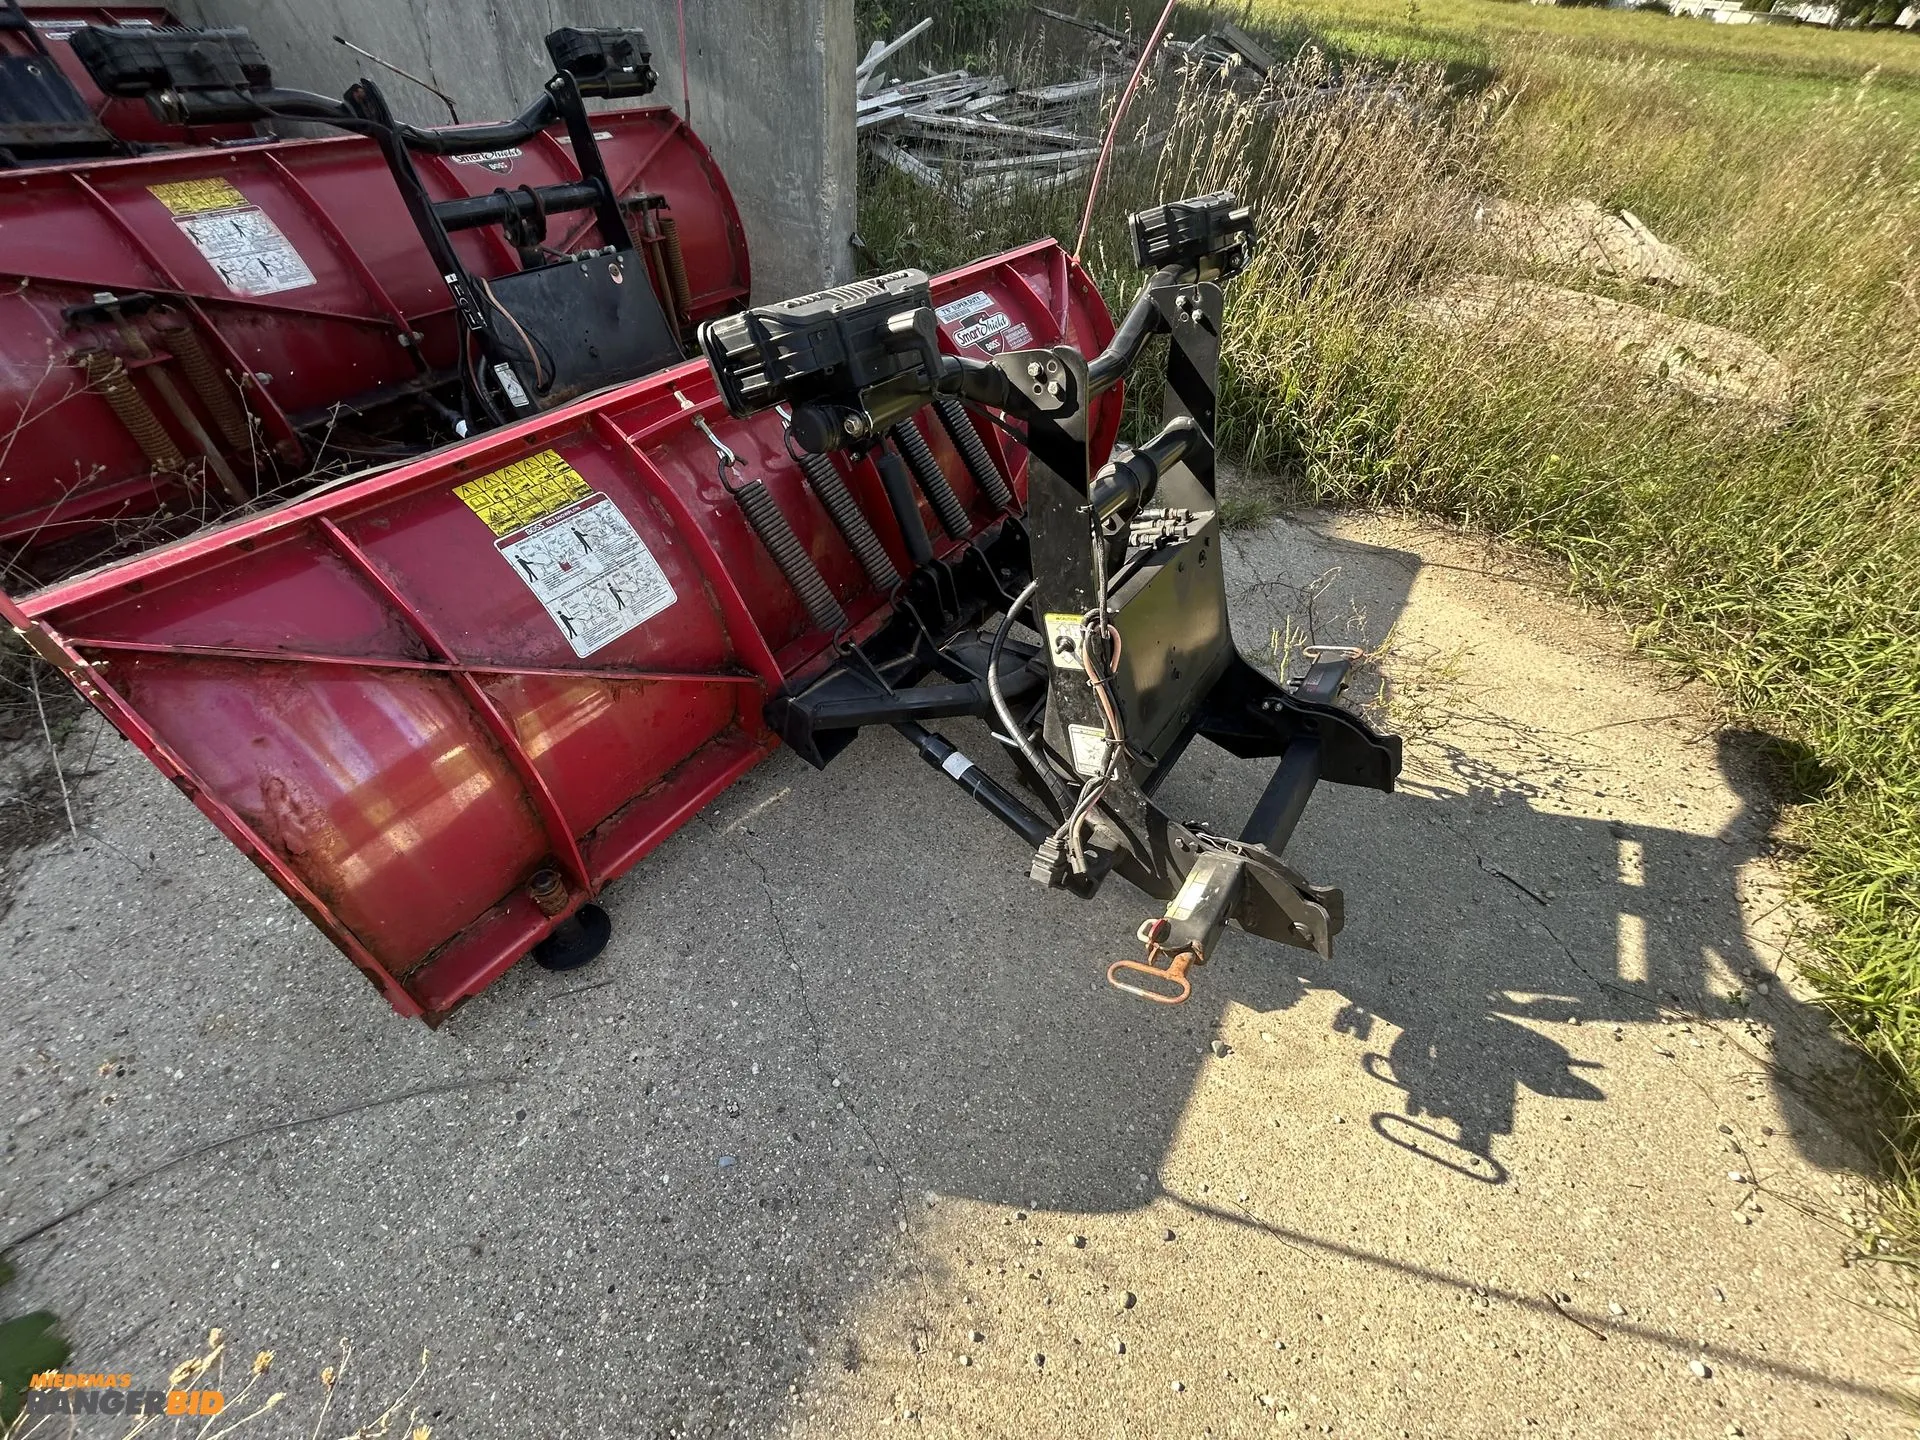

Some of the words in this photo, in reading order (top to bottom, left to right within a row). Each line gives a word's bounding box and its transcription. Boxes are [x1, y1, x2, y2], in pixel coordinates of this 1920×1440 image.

[956, 314, 1008, 345] SmartShield
[985, 338, 1001, 352] BOSS
[525, 522, 545, 535] BOSS
